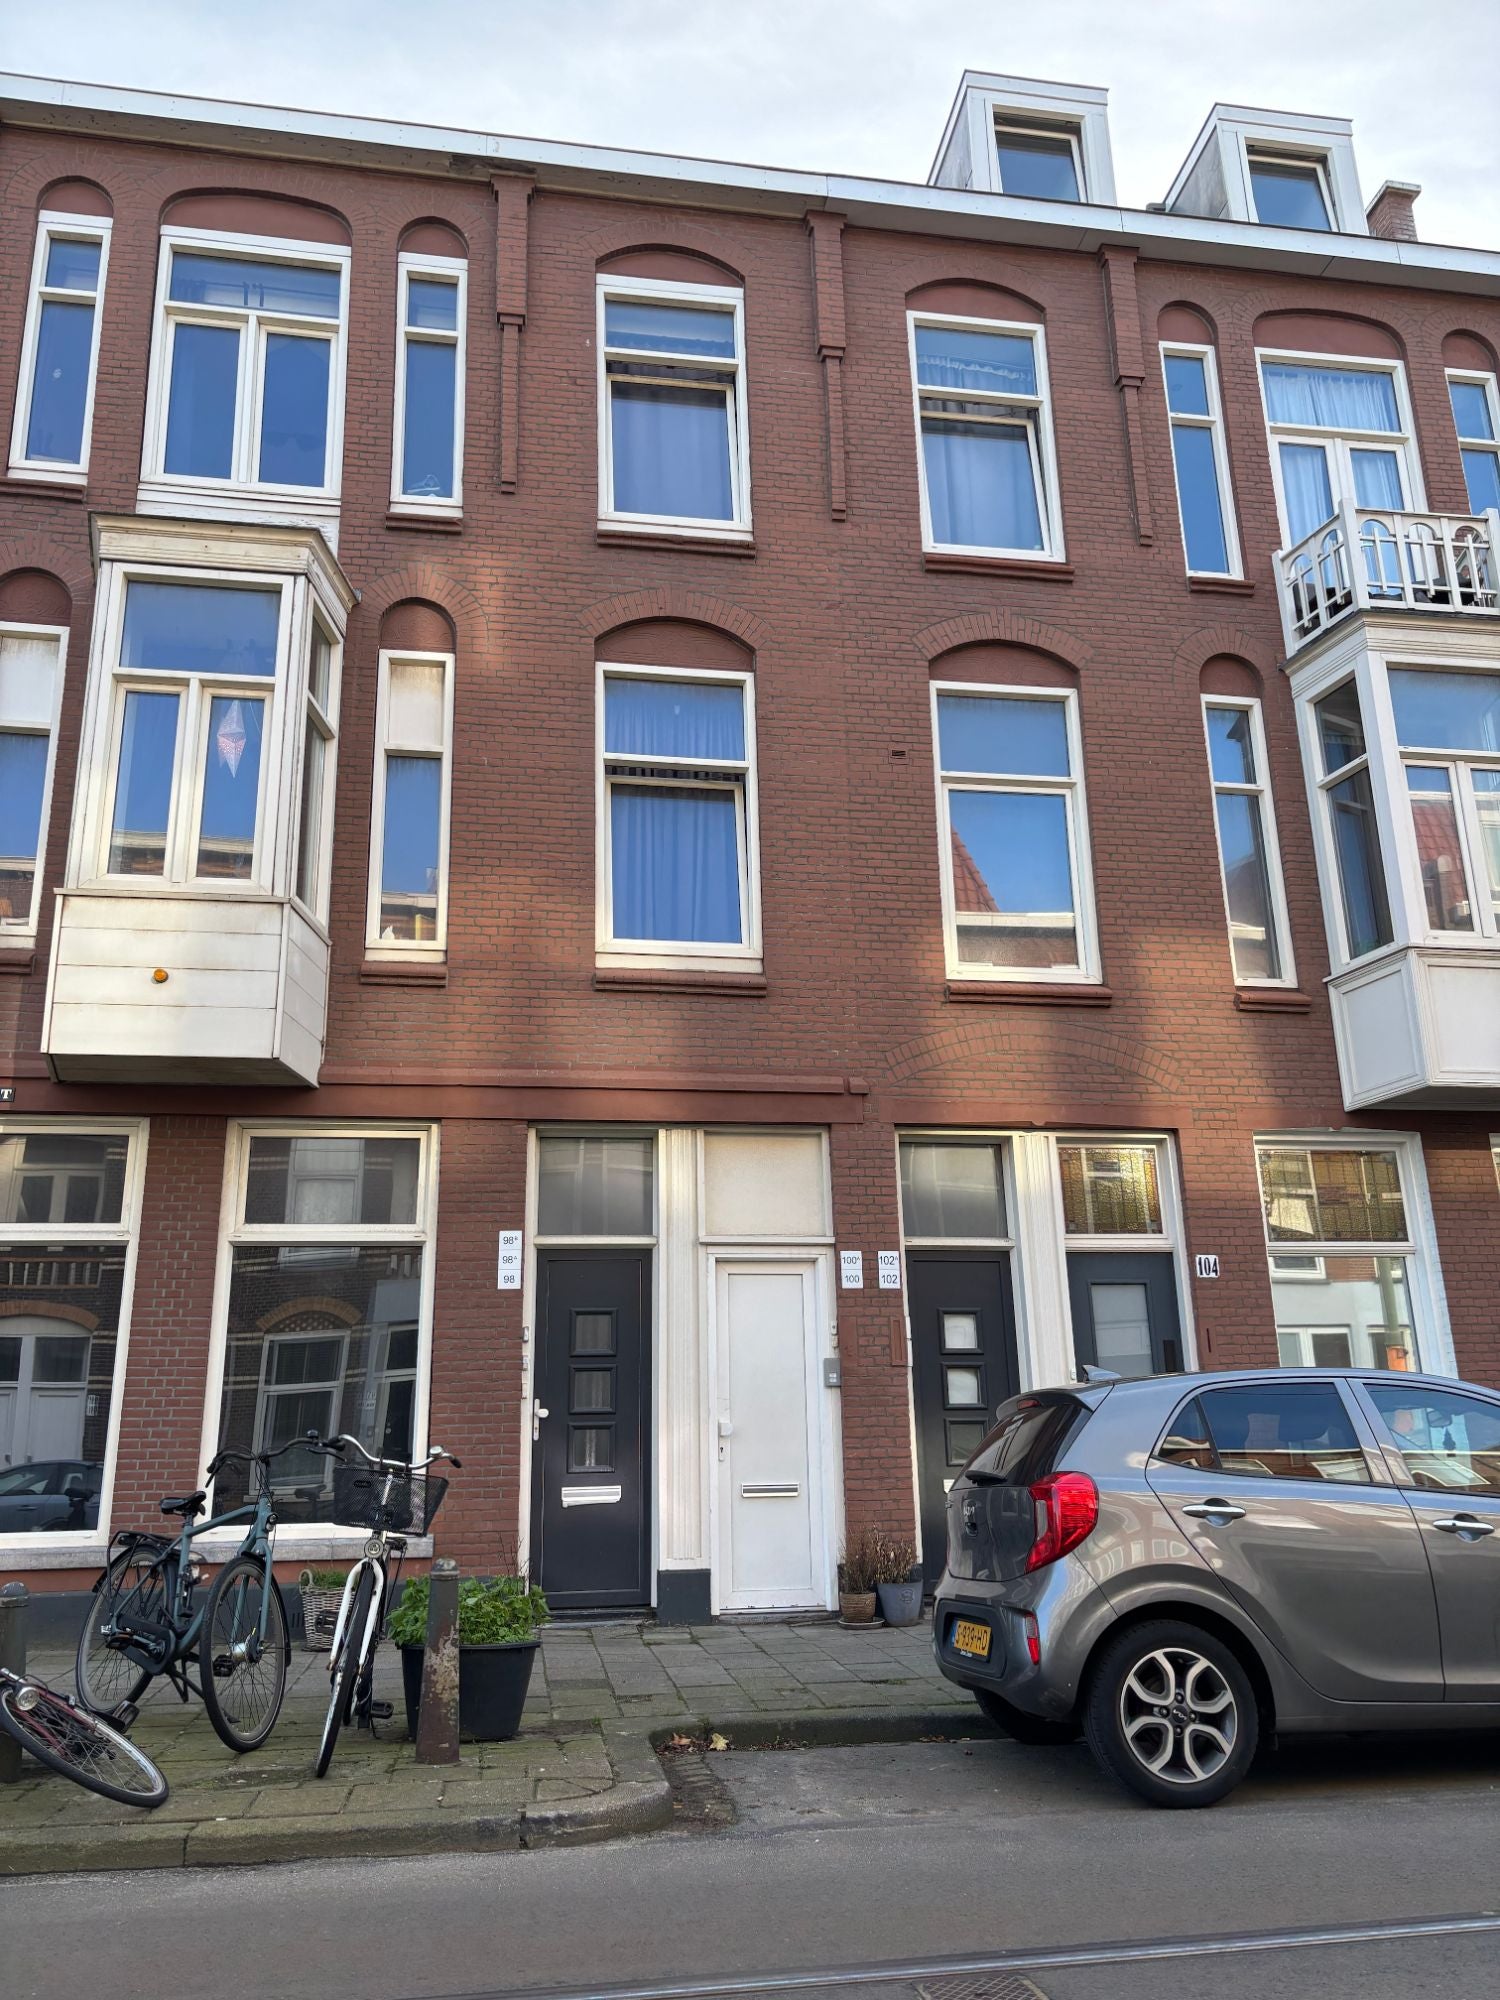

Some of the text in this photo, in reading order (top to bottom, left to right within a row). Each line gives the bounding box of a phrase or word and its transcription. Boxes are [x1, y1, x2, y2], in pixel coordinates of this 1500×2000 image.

[1198, 1256, 1218, 1276] 104
[503, 1274, 515, 1284] 98
[844, 1274, 860, 1283] 100
[881, 1274, 898, 1284] 102
